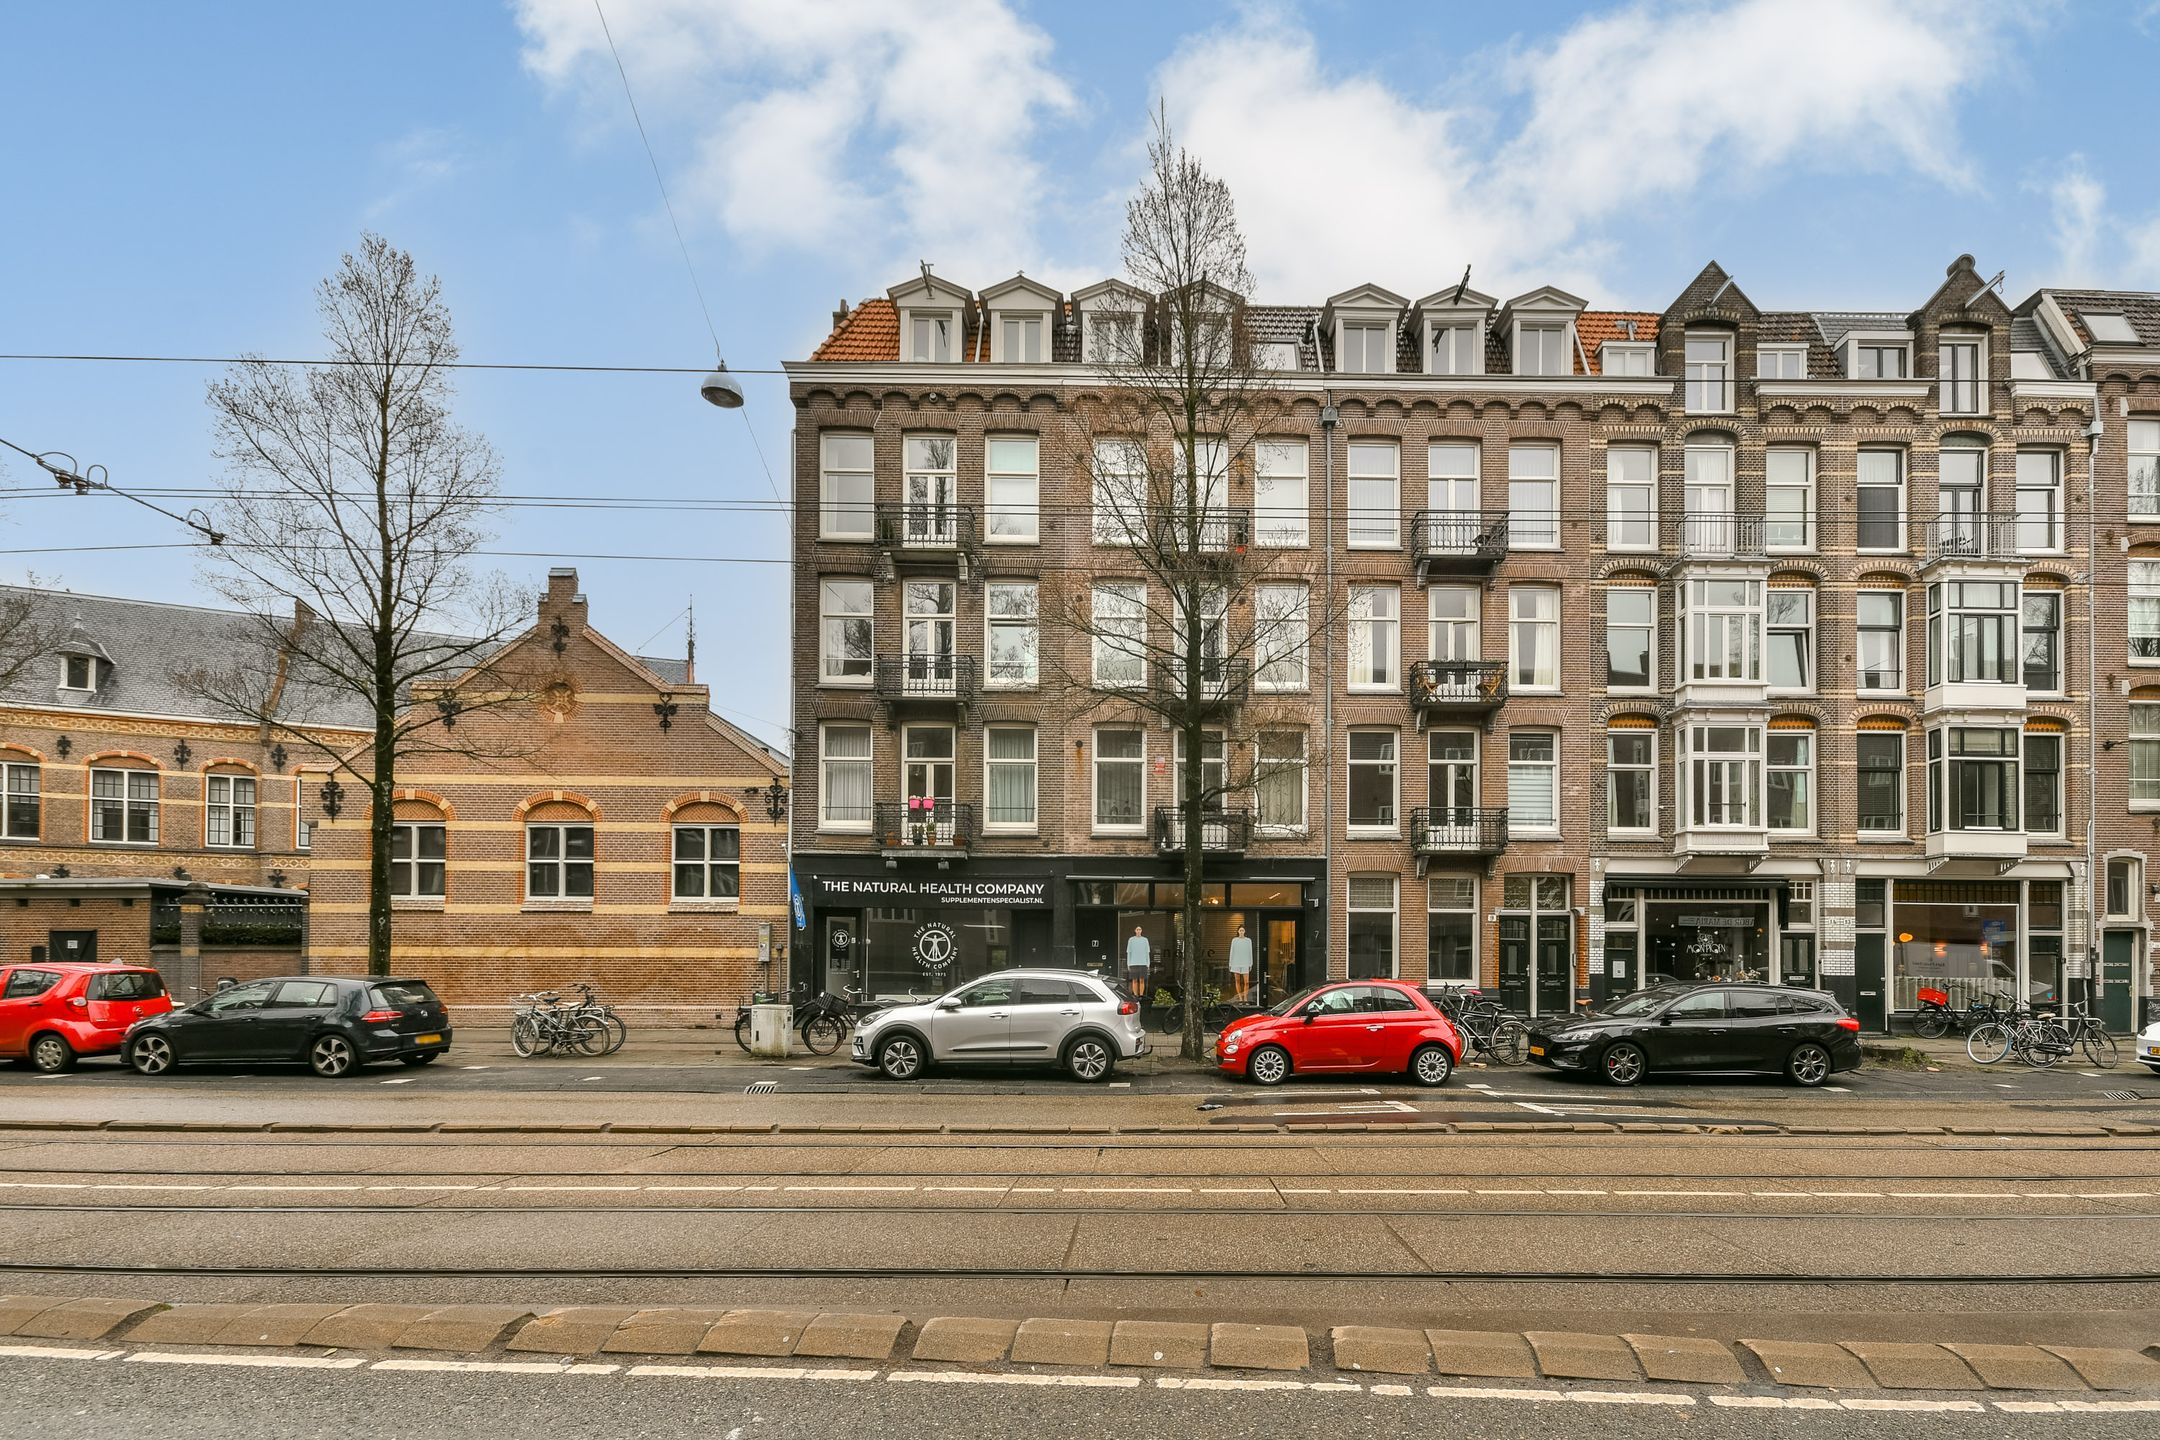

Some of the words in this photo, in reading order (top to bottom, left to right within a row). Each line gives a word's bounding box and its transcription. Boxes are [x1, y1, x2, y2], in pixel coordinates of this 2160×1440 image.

[822, 881, 850, 892] THE
[853, 881, 917, 893] NATURAL
[919, 882, 972, 894] HEALTH
[975, 883, 1045, 895] COMPANY
[913, 926, 925, 939] THE
[927, 921, 956, 939] NATURAL
[912, 946, 931, 969] HEALTH
[933, 946, 959, 970] COMPANY
